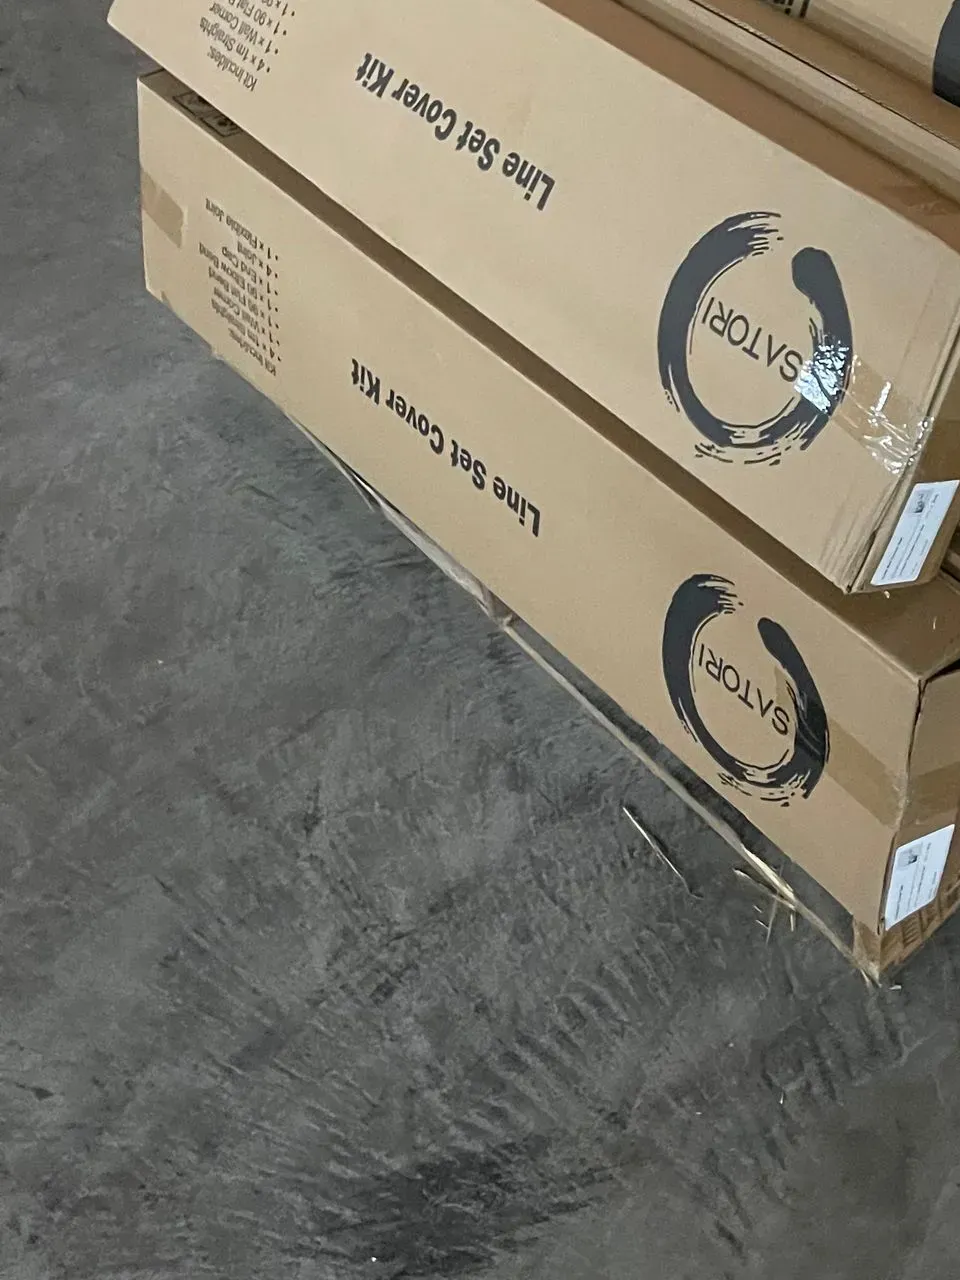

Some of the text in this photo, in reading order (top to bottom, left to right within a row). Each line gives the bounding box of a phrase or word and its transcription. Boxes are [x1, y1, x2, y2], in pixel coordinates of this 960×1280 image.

[209, 2, 239, 30] Corner
[254, 8, 267, 26] 90
[199, 17, 236, 51] Straights
[238, 24, 258, 45] Wall
[236, 44, 249, 61] 1m
[257, 58, 265, 71] 4
[355, 52, 556, 211] Line Set Cover Kit
[702, 297, 803, 382] SATORI
[351, 358, 541, 537] Line Set Cover Kit
[699, 643, 790, 736] SATORI
